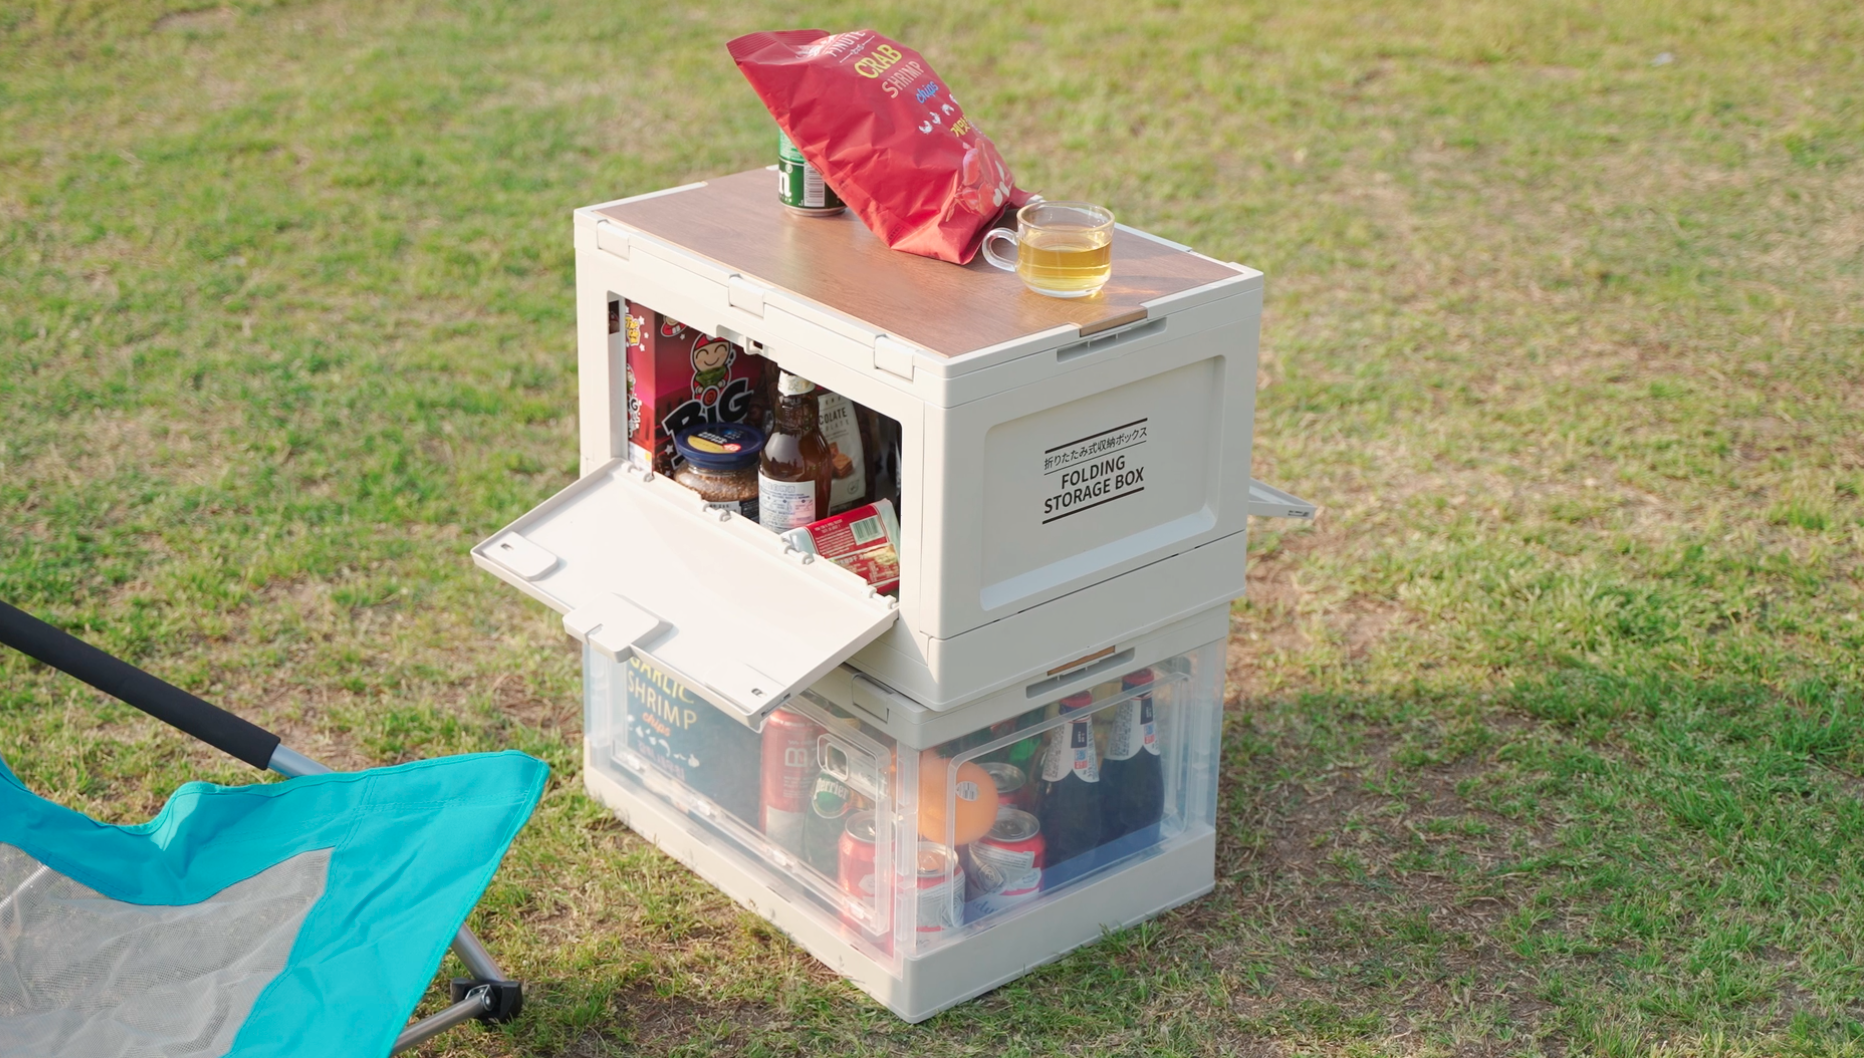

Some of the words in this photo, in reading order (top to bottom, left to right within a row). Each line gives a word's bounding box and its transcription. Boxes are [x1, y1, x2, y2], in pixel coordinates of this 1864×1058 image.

[854, 44, 902, 79] CRAB
[881, 60, 925, 98] SHRIMP
[915, 81, 939, 104] chips
[950, 114, 970, 137] 게맛
[819, 407, 847, 426] COLATE
[1044, 427, 1147, 470] 折りたたみ式収納ボックス
[1061, 455, 1125, 489] FOLDING
[1044, 478, 1111, 514] STORAGE
[1115, 467, 1144, 490] BOX
[628, 669, 697, 730] SHRIMP
